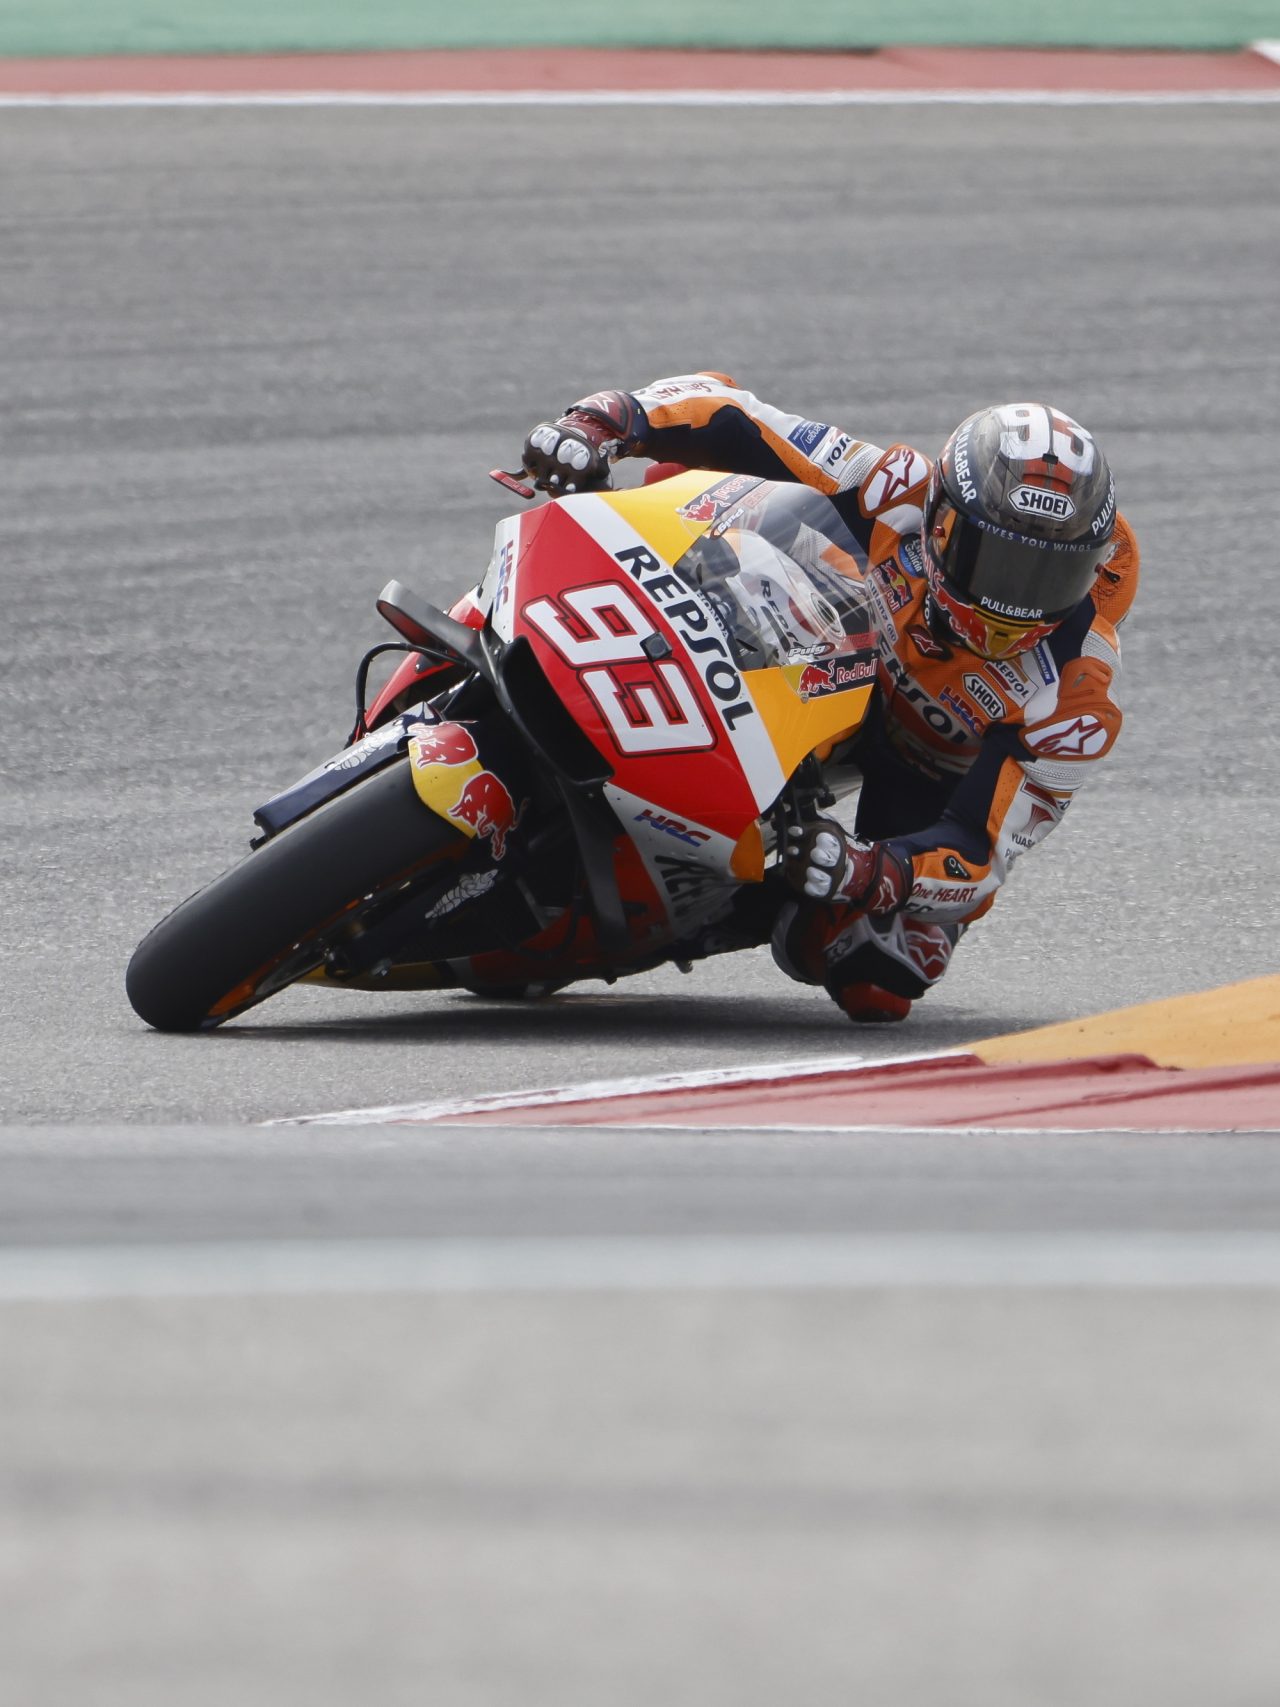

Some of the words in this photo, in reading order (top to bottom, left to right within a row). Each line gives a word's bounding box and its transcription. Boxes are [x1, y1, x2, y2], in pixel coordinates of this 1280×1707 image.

[1000, 403, 1094, 475] 93
[1018, 490, 1069, 516] SHOEI
[977, 520, 1014, 541] GIVES
[1020, 535, 1047, 549] YOU
[1053, 542, 1091, 553] WINGS
[696, 591, 729, 638] HONDA
[981, 596, 1043, 618] PULL&BEAR
[614, 545, 754, 732] REPSOL
[520, 579, 718, 758] 93
[993, 660, 1030, 699] REPSOL
[967, 678, 1002, 717] SHOEI
[633, 808, 712, 848] HRC
[910, 882, 933, 900] One
[932, 887, 978, 903] HEART
